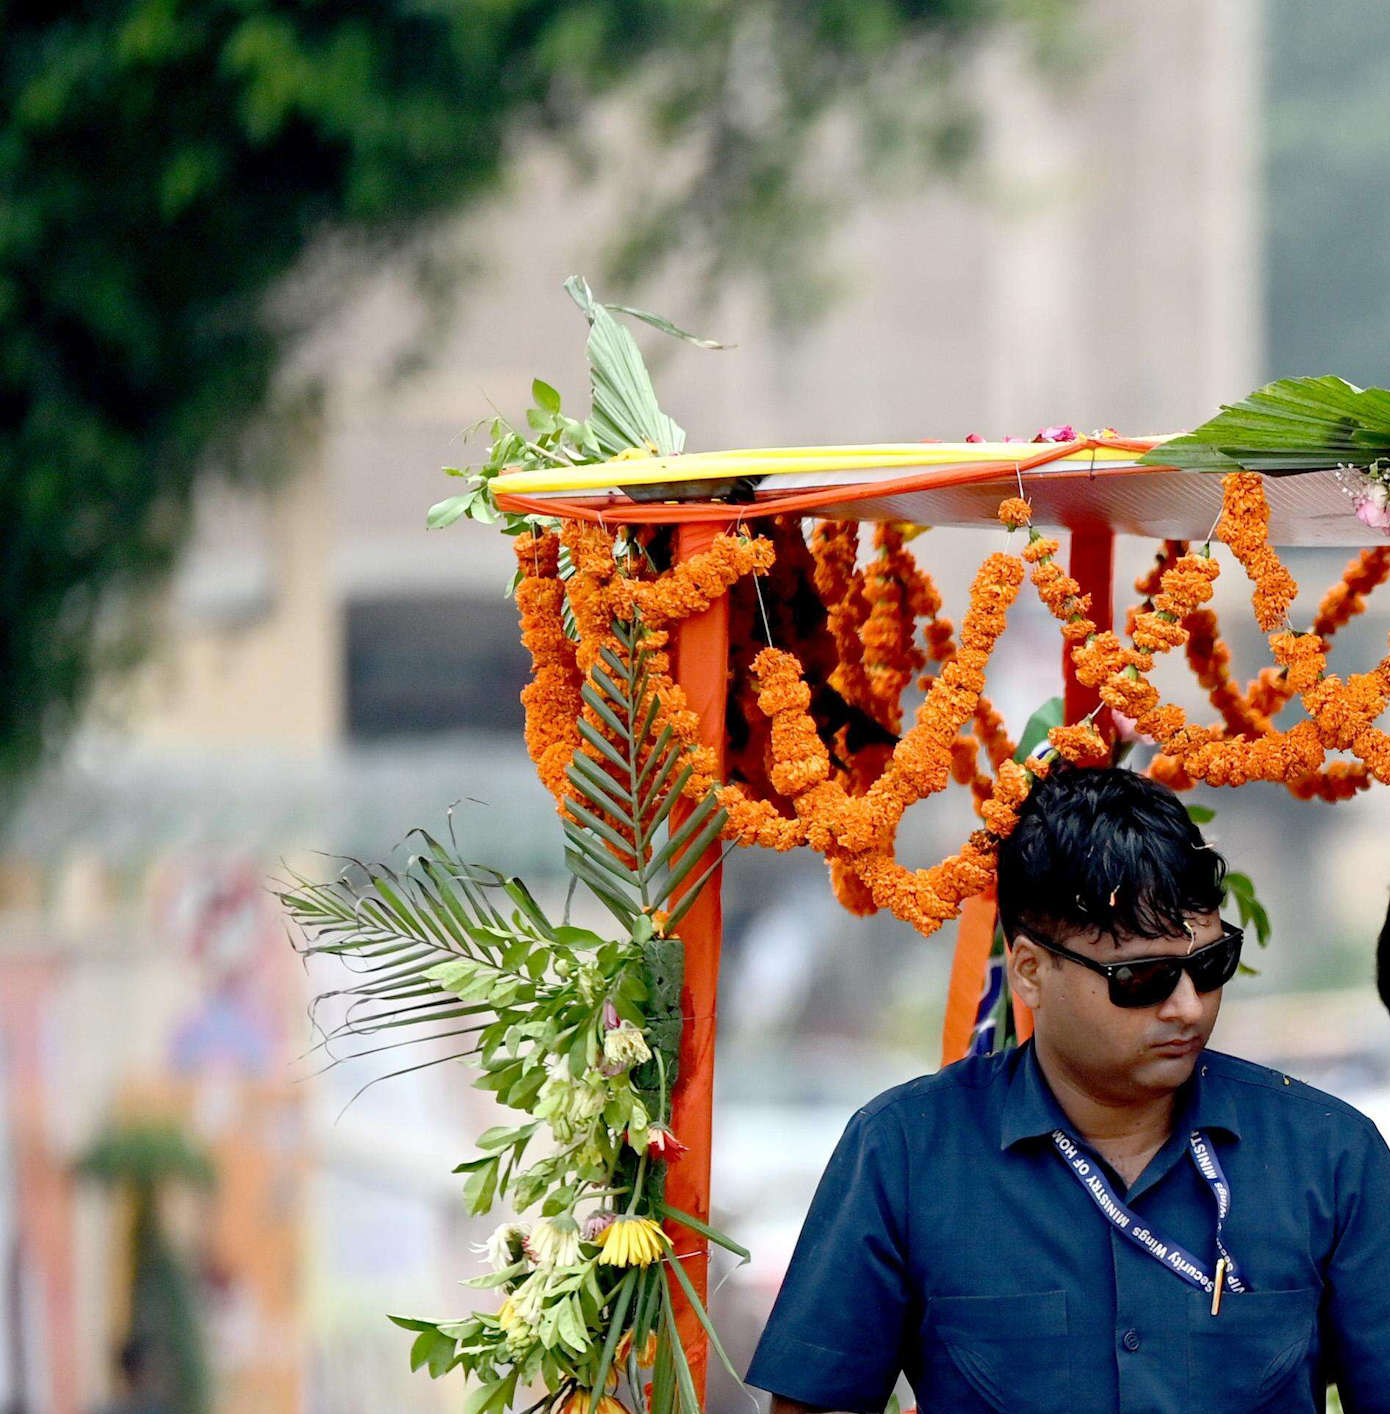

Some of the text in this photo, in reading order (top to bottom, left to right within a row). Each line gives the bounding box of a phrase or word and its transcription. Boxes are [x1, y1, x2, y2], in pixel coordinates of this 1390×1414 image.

[1051, 1128, 1215, 1293] Security Wings MINISTRY OF HOM
[1227, 1275, 1246, 1293] VIP
